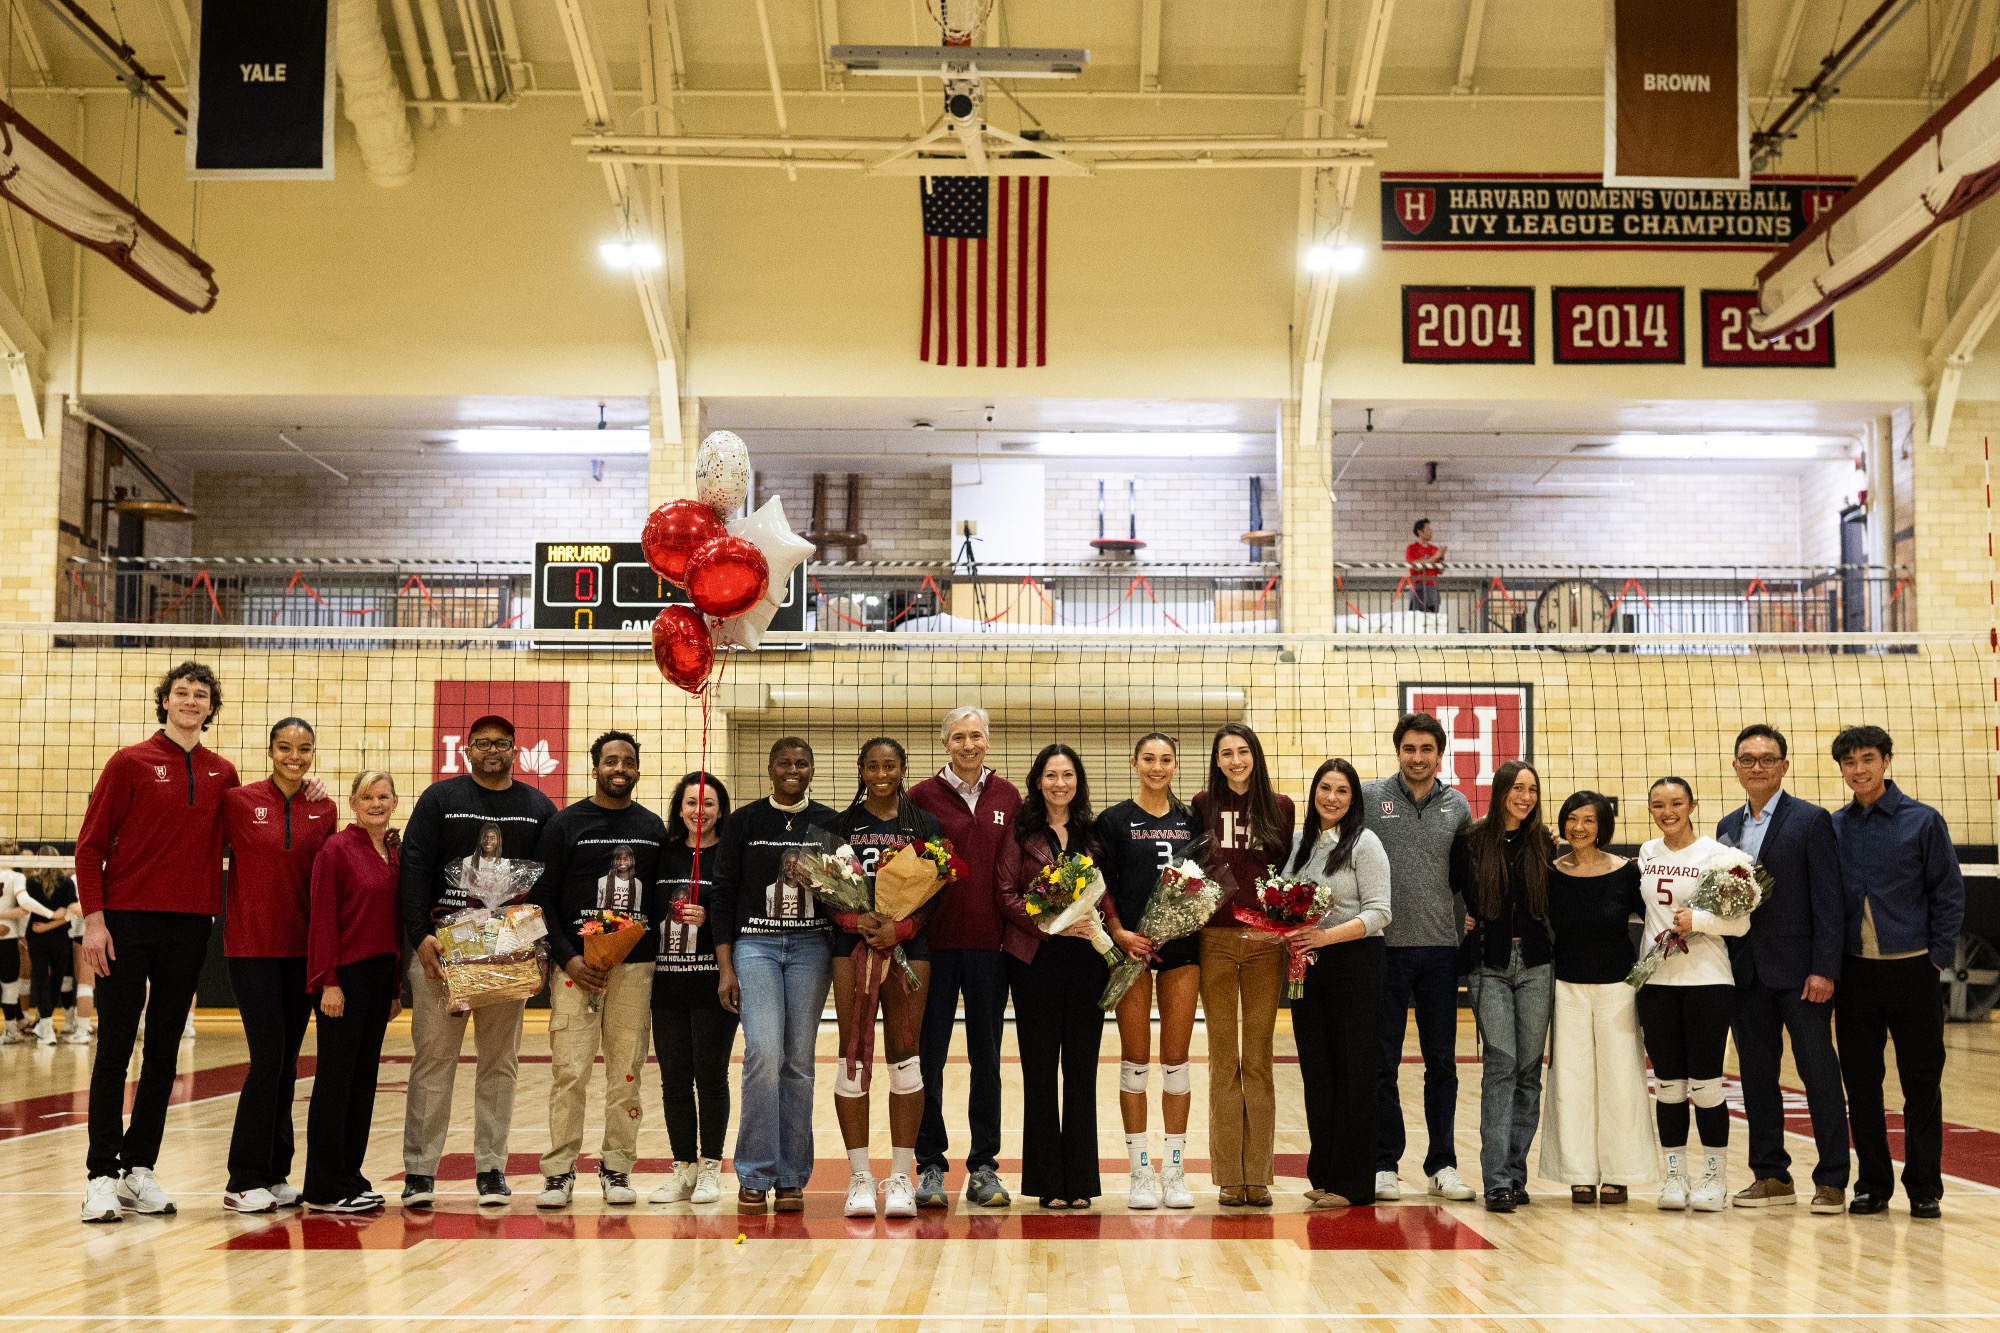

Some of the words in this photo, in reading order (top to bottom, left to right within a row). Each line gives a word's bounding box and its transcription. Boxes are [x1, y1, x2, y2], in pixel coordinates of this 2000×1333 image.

[240, 63, 287, 82] YALE
[1643, 73, 1711, 92] BROWN
[1404, 192, 1427, 221] H
[1449, 188, 1550, 210] HARVARD
[1556, 189, 1655, 211] WOMEN'S
[1660, 190, 1792, 212] VOLLEYBALL
[1450, 214, 1499, 234] IVY
[1506, 214, 1615, 235] LEAGUE
[1623, 214, 1792, 237] CHAMPIONS
[1417, 303, 1523, 348] 2004
[1571, 304, 1669, 348] 2014
[1721, 306, 1816, 352] 25
[548, 545, 612, 562] HARVARD
[575, 568, 594, 600] 0
[622, 619, 654, 631] GAM
[1436, 706, 1498, 786] H
[993, 810, 1005, 826] H
[1130, 829, 1191, 840] HARVARD
[1155, 841, 1174, 870] 3
[1642, 864, 1700, 878] HARVARD
[445, 888, 468, 898] PEYTO
[1656, 878, 1674, 906] 5
[748, 916, 781, 927] PEYTON
[782, 919, 814, 928] HOLLIS
[668, 954, 696, 963] HOLLIS
[697, 954, 715, 962] #22
